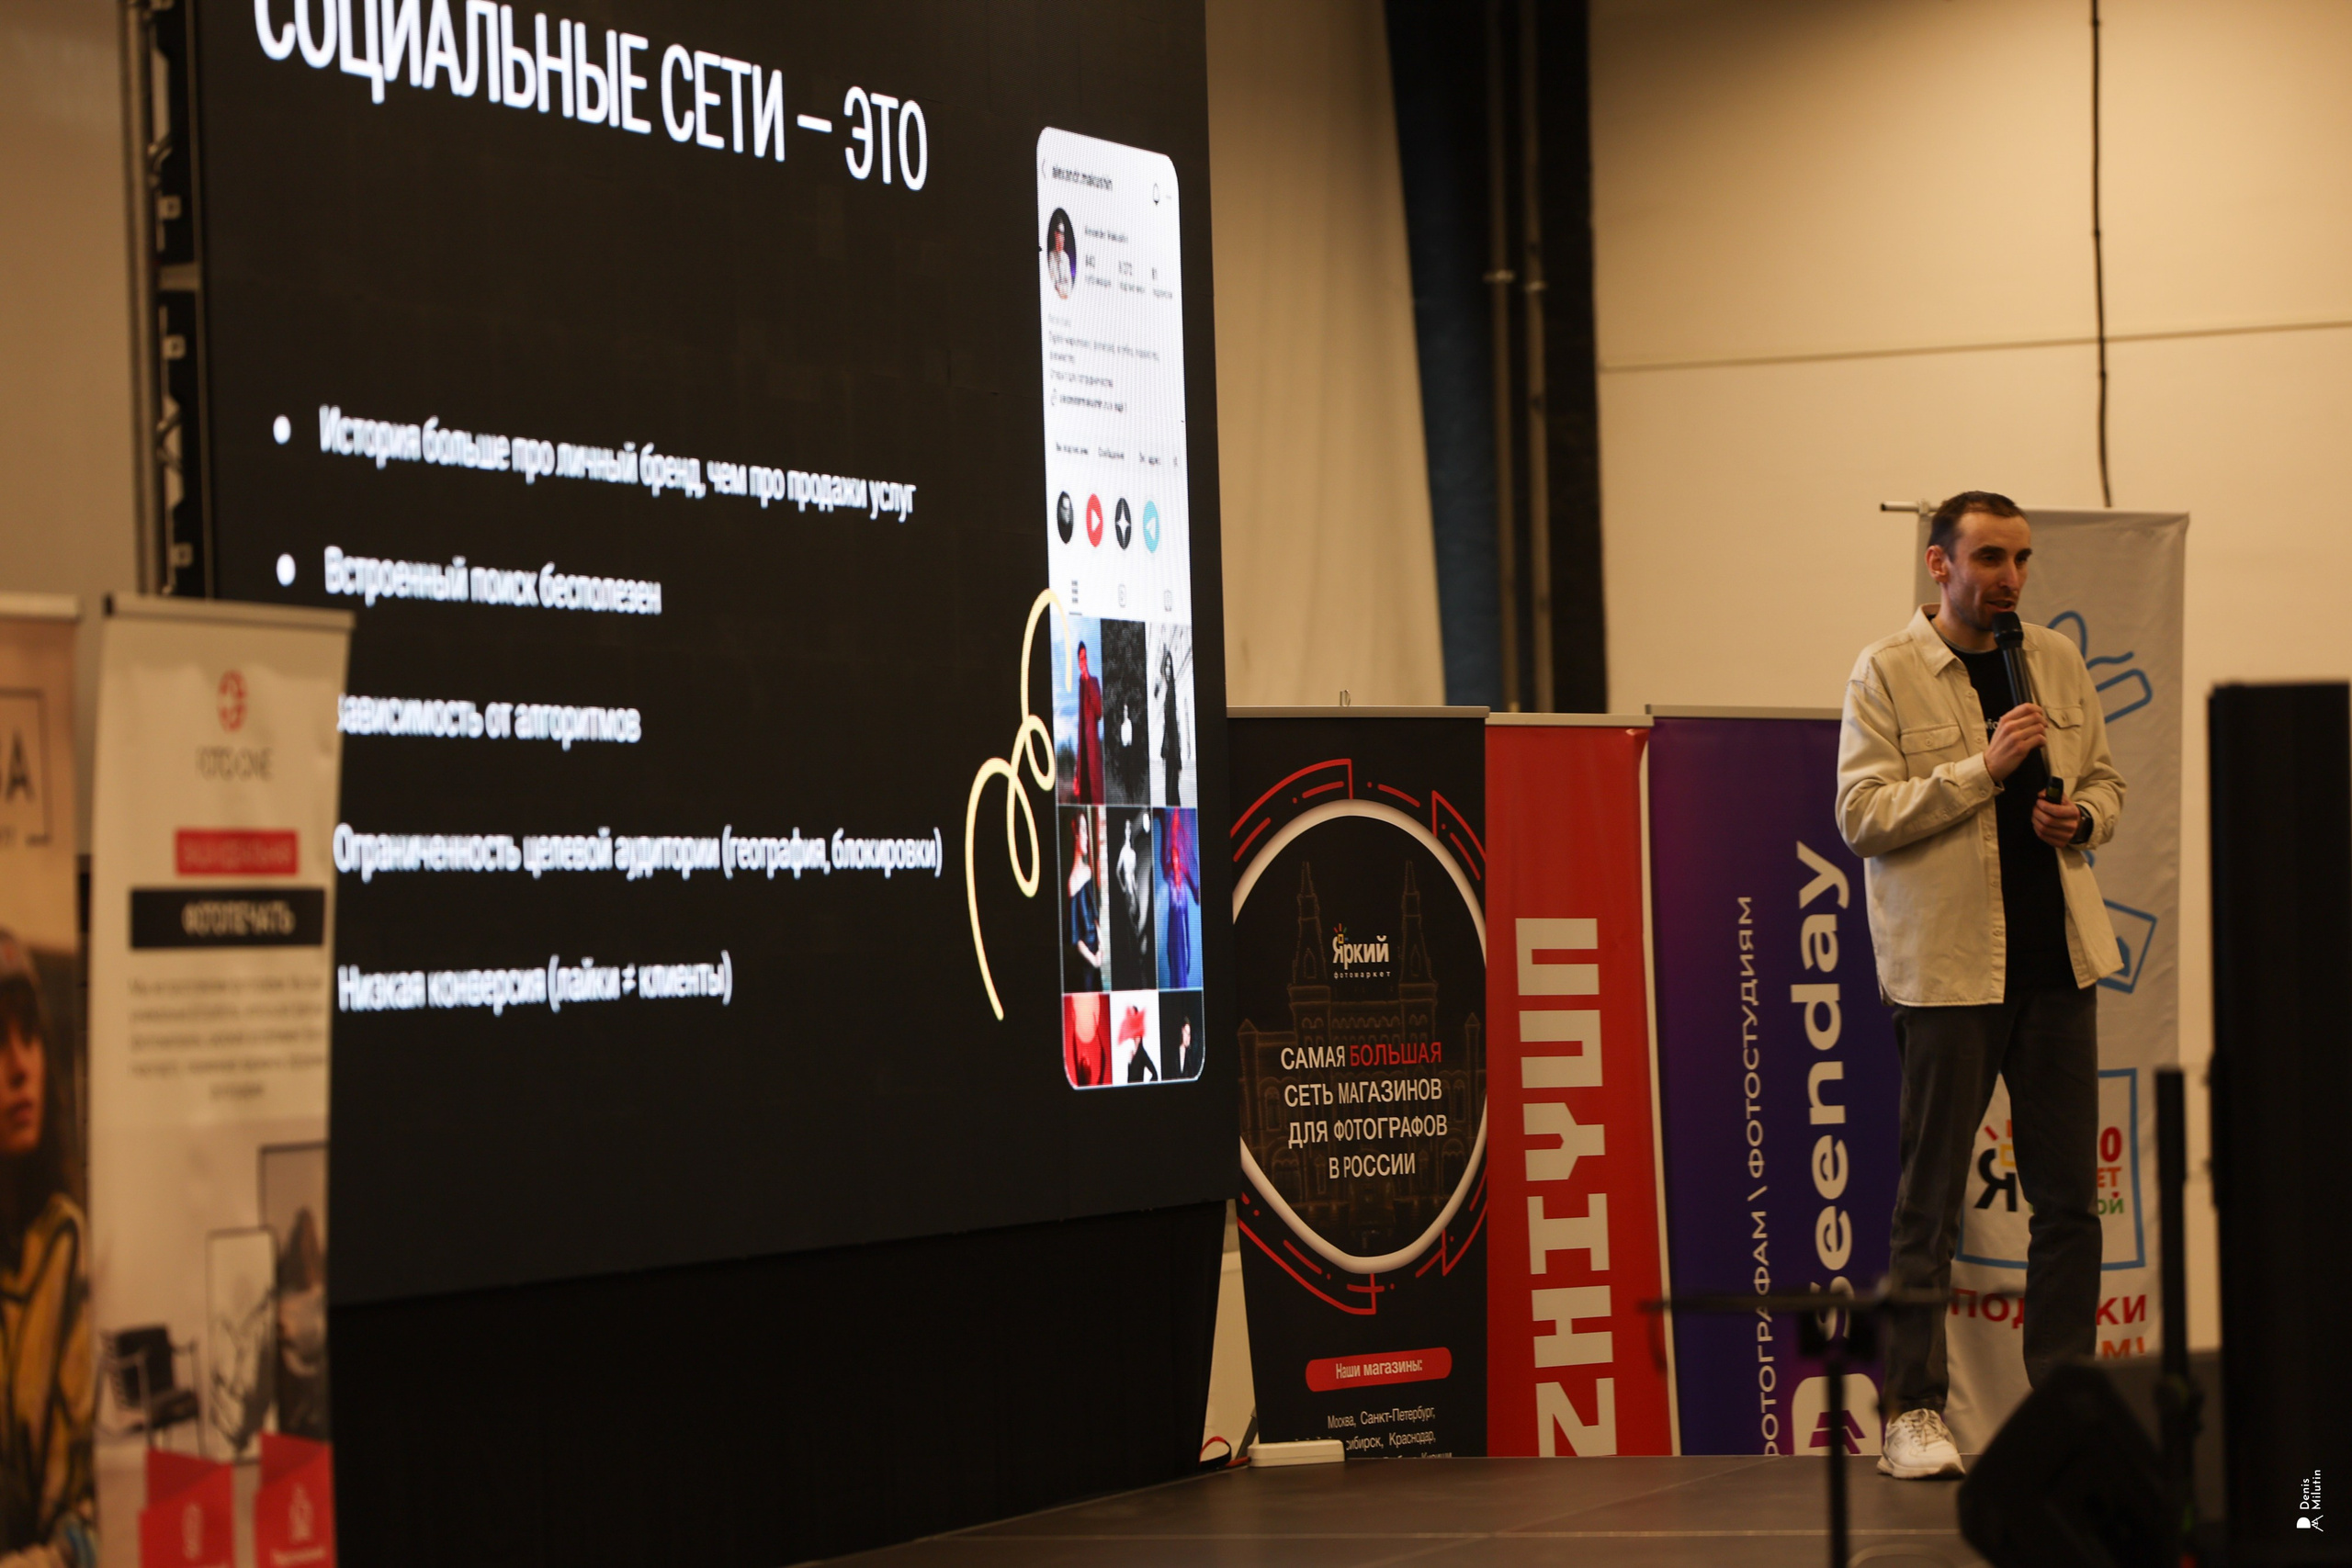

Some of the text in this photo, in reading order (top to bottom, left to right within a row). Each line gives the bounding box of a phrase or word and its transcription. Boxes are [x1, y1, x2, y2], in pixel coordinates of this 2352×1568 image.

[254, 0, 651, 134] СОЦИАЛЬНЫЕ
[661, 44, 786, 162] СЕТИ
[843, 85, 928, 190] ЭТО
[319, 405, 917, 523] История больше про личный бренд, чем про продажи услуг
[324, 545, 662, 615] Встроенный поиск бесполезен
[484, 702, 514, 739] от
[514, 703, 641, 752] алгоритмов
[333, 822, 522, 884] Ограниченность
[523, 826, 614, 880] целевой
[614, 834, 720, 881] аудитории
[721, 824, 831, 879] (география,
[831, 826, 943, 878] блокировки)
[1332, 934, 1390, 970] Яркий
[337, 964, 426, 1011] Низкая
[427, 967, 547, 1018] конверсия
[548, 953, 621, 1013] (лайки
[639, 950, 733, 1006] клиенты)
[1333, 971, 1391, 980] фотомаркет
[1280, 1042, 1442, 1070] САМАЯ БОЛЬШАЯ
[1737, 897, 1765, 1179] ФОТОСТУДИЯМ
[1284, 1078, 1442, 1107] СЕТЬ МАГАЗИНОВ
[1288, 1114, 1448, 1149] ДЛЯ ФОТОГРАФОВ
[1329, 1153, 1416, 1179] В РОССИИ
[1516, 918, 1617, 1457] ZHIYUN
[1949, 1288, 2147, 1329] ПОКИ
[1335, 1359, 1423, 1379] Наши магазины:
[1328, 1405, 1436, 1429] Москва, Санкт-Петербург,
[1388, 1430, 1436, 1448] Краснодар,
